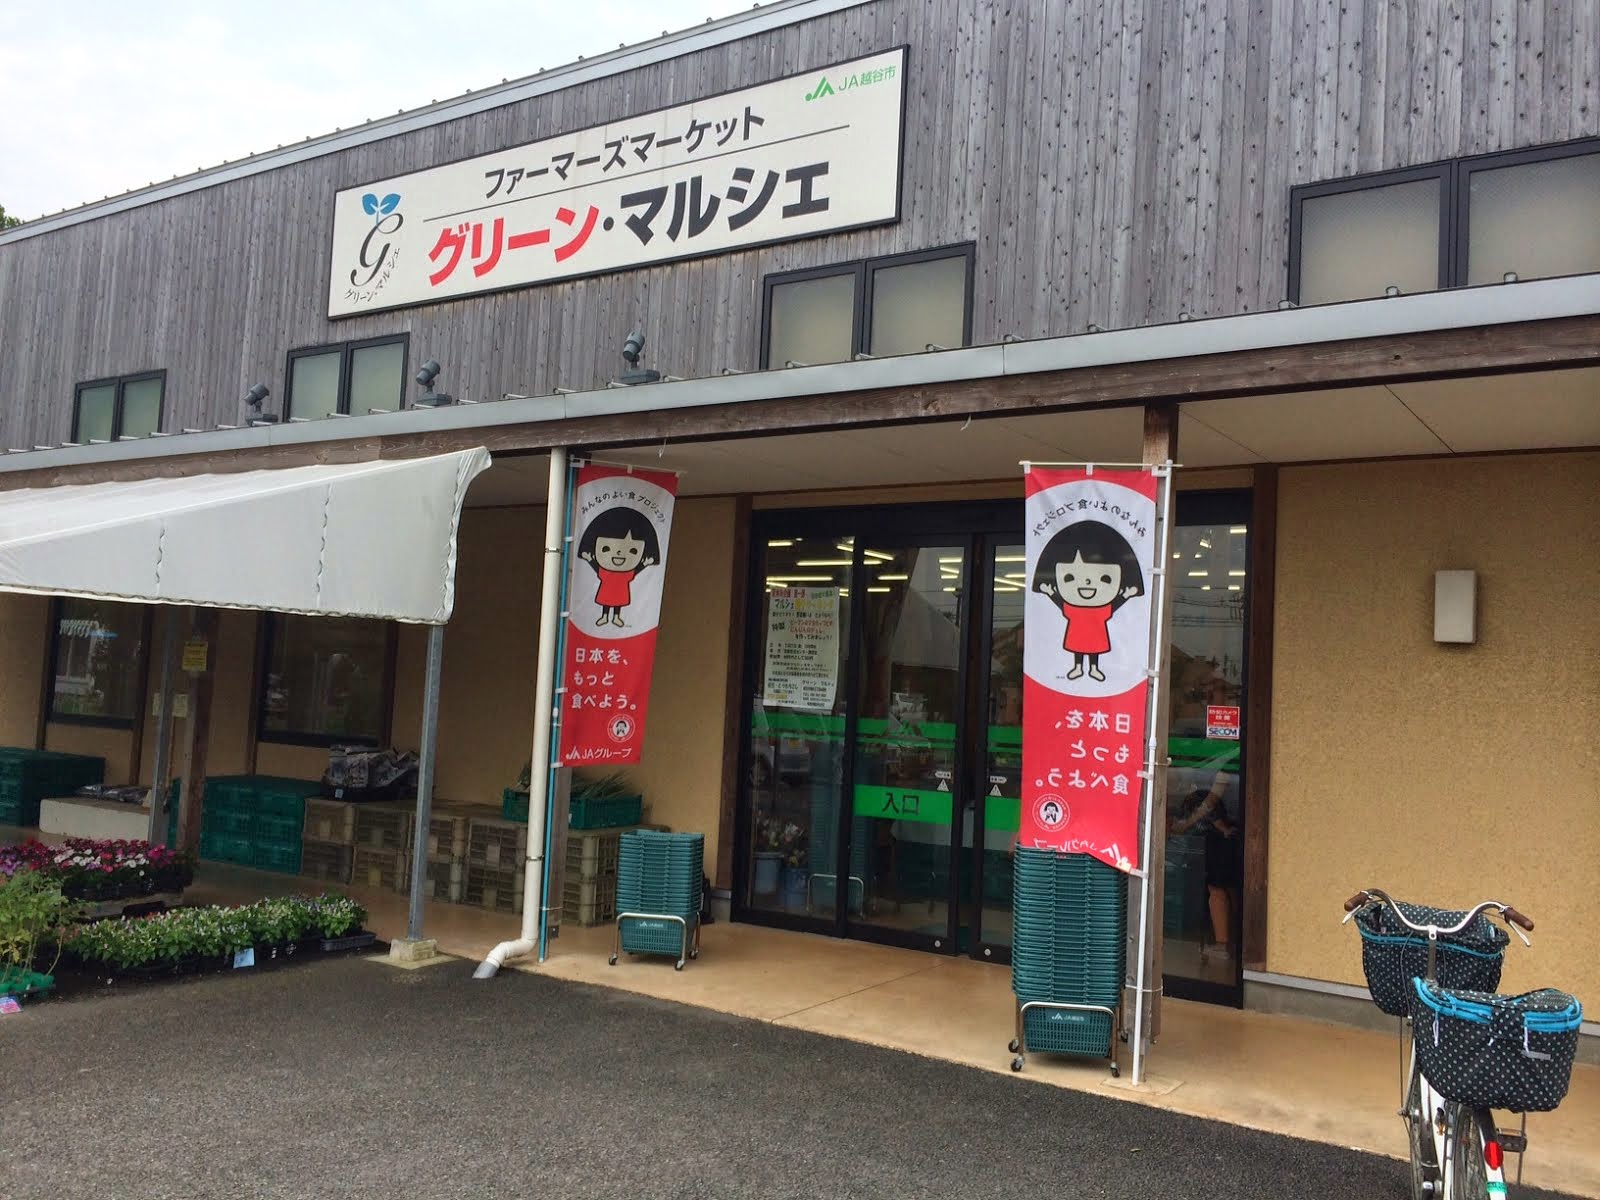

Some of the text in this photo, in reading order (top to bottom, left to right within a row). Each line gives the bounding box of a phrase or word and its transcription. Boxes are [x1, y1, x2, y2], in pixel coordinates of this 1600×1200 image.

[838, 65, 896, 92] JA越谷市
[485, 106, 765, 199] ファーマーズマーケット
[427, 161, 829, 286] グリーン・マルシェ
[575, 648, 629, 666] 日本を、
[573, 670, 614, 686] もっと
[571, 693, 638, 711] 食べよう。
[1208, 727, 1237, 736] SECOM
[582, 747, 633, 760] JAグループ
[882, 792, 919, 816] 入口
